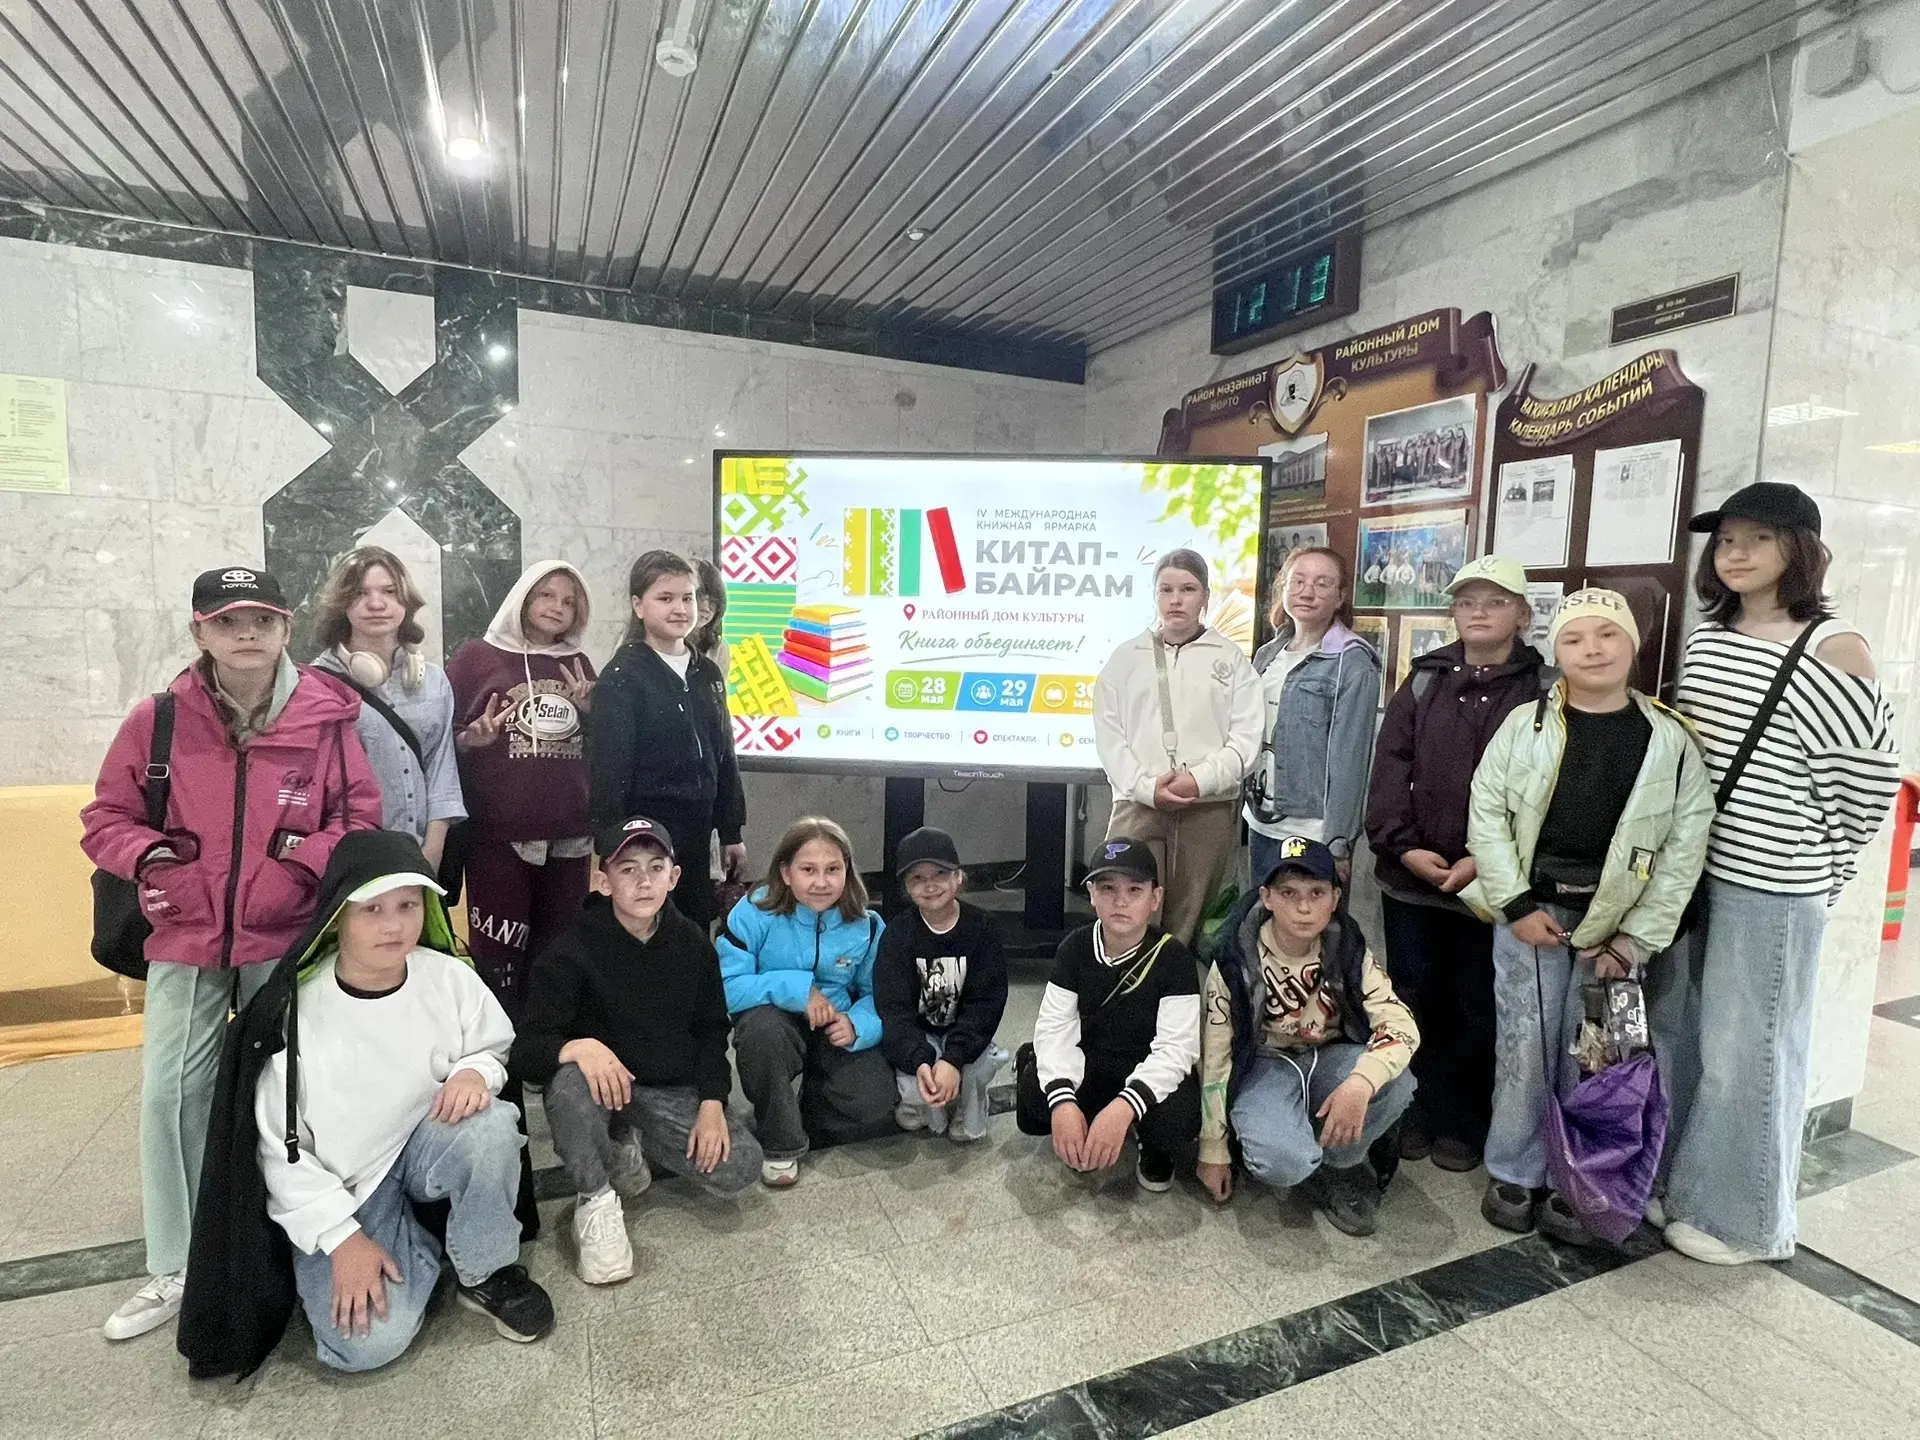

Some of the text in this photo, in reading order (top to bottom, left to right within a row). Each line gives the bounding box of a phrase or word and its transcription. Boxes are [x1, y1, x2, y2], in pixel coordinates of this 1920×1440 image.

[1335, 316, 1441, 361] РАЙОННЫЙ ДОМ
[1351, 342, 1419, 373] КУЛЬТУРЫ
[1583, 352, 1666, 407] КАЛЕНДАРЫ
[1508, 377, 1653, 445] КАЛЕНДАРЬ СОБЫТИЙ
[976, 508, 1098, 521] IV МЕЖДУНАРОДНАЯ
[976, 520, 1097, 532] КНИЖНАЯ ЯРМАРКА
[975, 539, 1119, 566] КИТАП-
[221, 582, 260, 590] TOYOTA
[974, 565, 1134, 598] БАЙРАМ
[921, 608, 1085, 623] РАЙОННЫЙ ДОМ КУЛЬТУРЫ
[898, 629, 1086, 658] Книга объединяет!
[920, 676, 947, 694] 28
[1001, 679, 1028, 697] 29
[920, 695, 944, 705] мая
[1000, 697, 1024, 707] мая
[836, 729, 861, 737] КНИГИ
[903, 731, 950, 740] ТВОРЧЕСТВО
[992, 734, 1037, 743] СПЕКТАКЛИ
[1078, 737, 1095, 745] СЕМ
[952, 769, 1005, 779] TeachTouch
